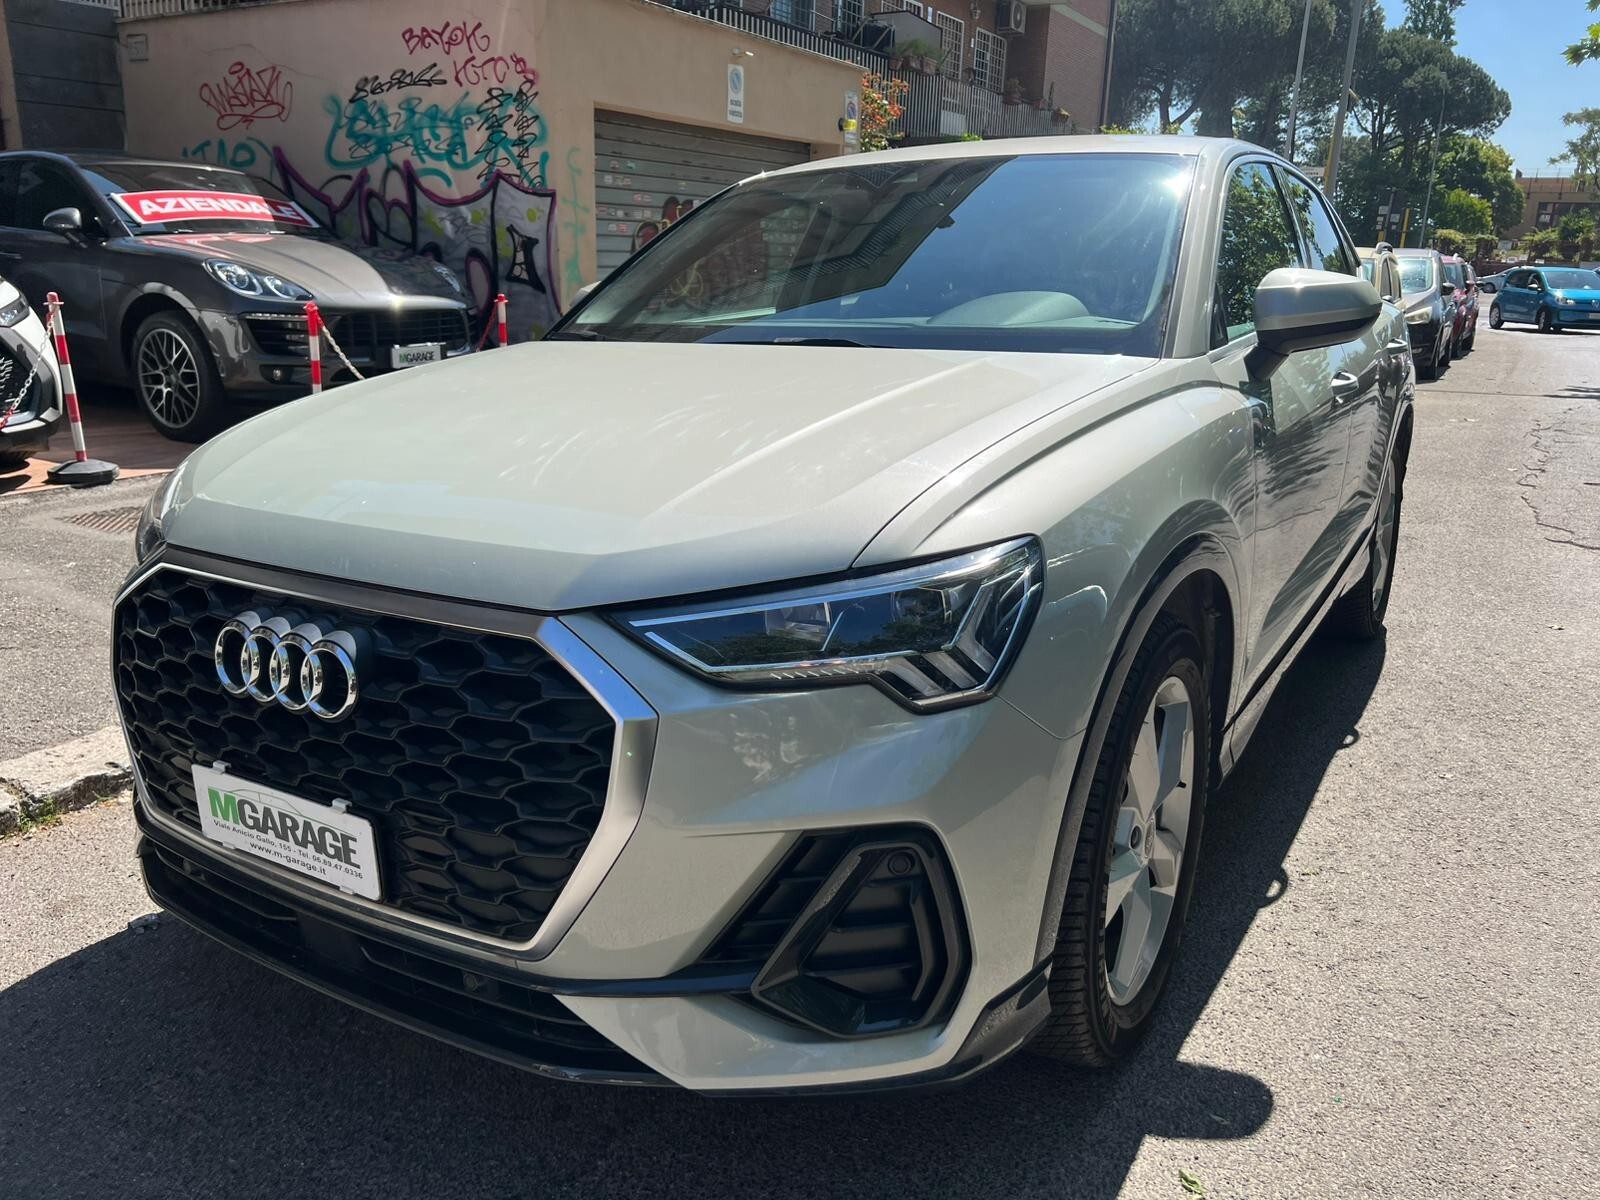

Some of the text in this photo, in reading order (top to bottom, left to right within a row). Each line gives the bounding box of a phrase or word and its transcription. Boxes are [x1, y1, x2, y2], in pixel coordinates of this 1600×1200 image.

[138, 197, 303, 220] AZIENDALE
[208, 787, 361, 869] MGARAGE
[214, 819, 231, 832] Viale
[232, 826, 255, 839] Anicio
[298, 848, 311, 860] Tel.
[250, 841, 327, 876] www.m-garage.it
